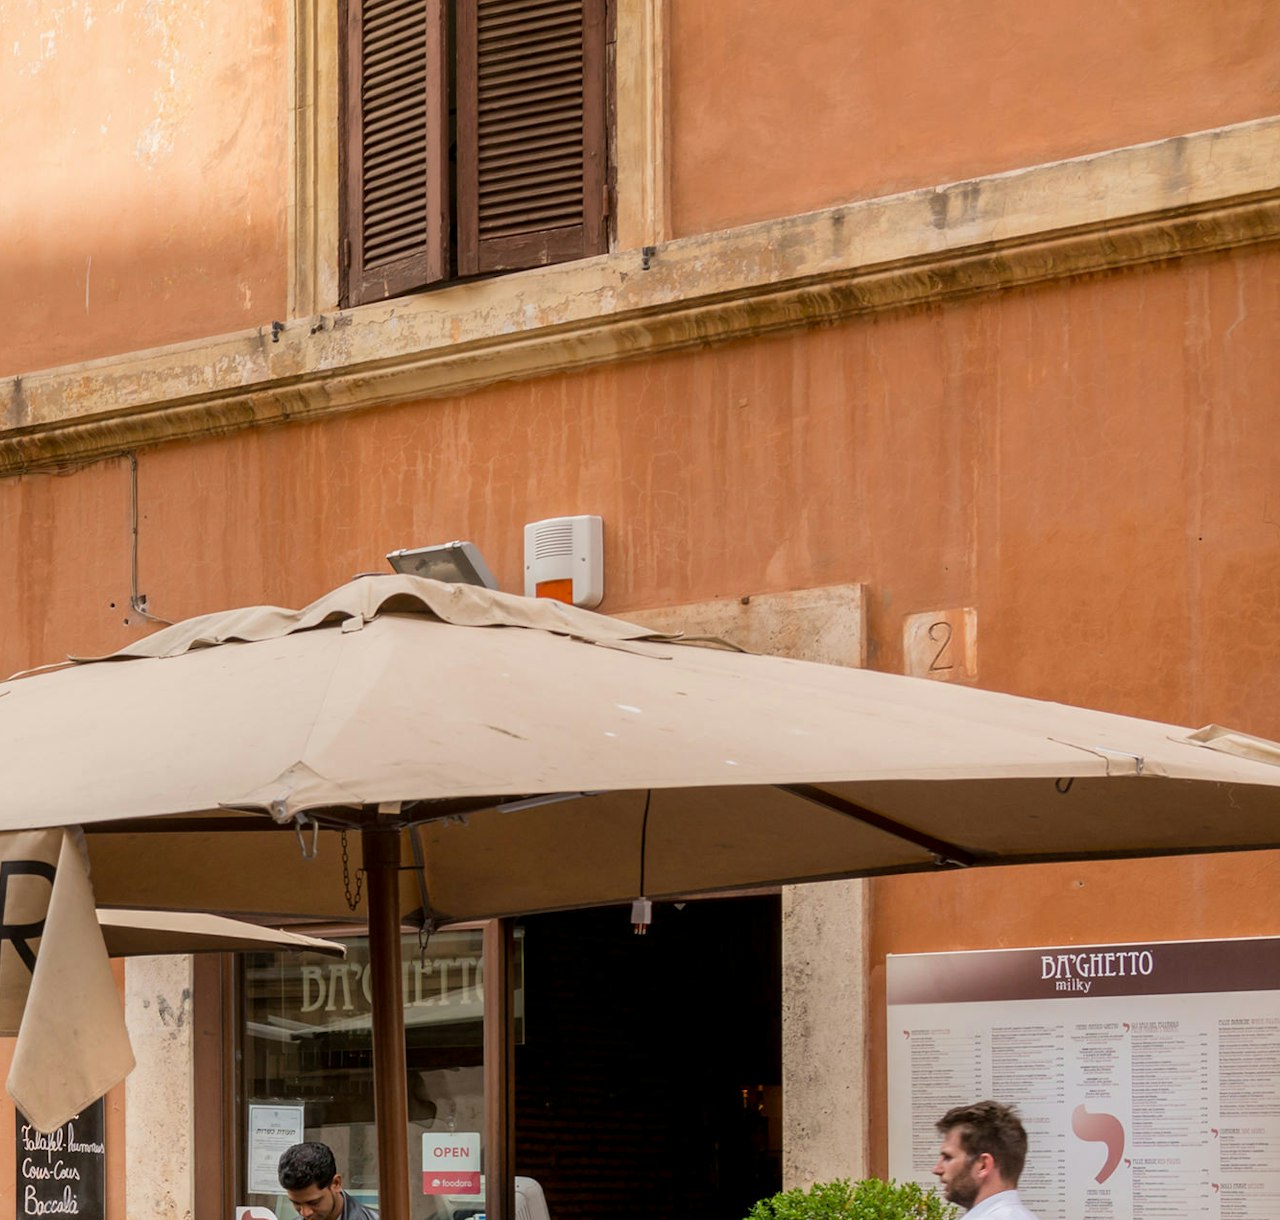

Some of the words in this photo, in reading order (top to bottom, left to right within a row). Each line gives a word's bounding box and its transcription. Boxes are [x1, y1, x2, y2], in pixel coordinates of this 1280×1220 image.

[928, 621, 955, 672] 2
[1055, 978, 1092, 994] milky
[433, 1147, 470, 1158] OPEN
